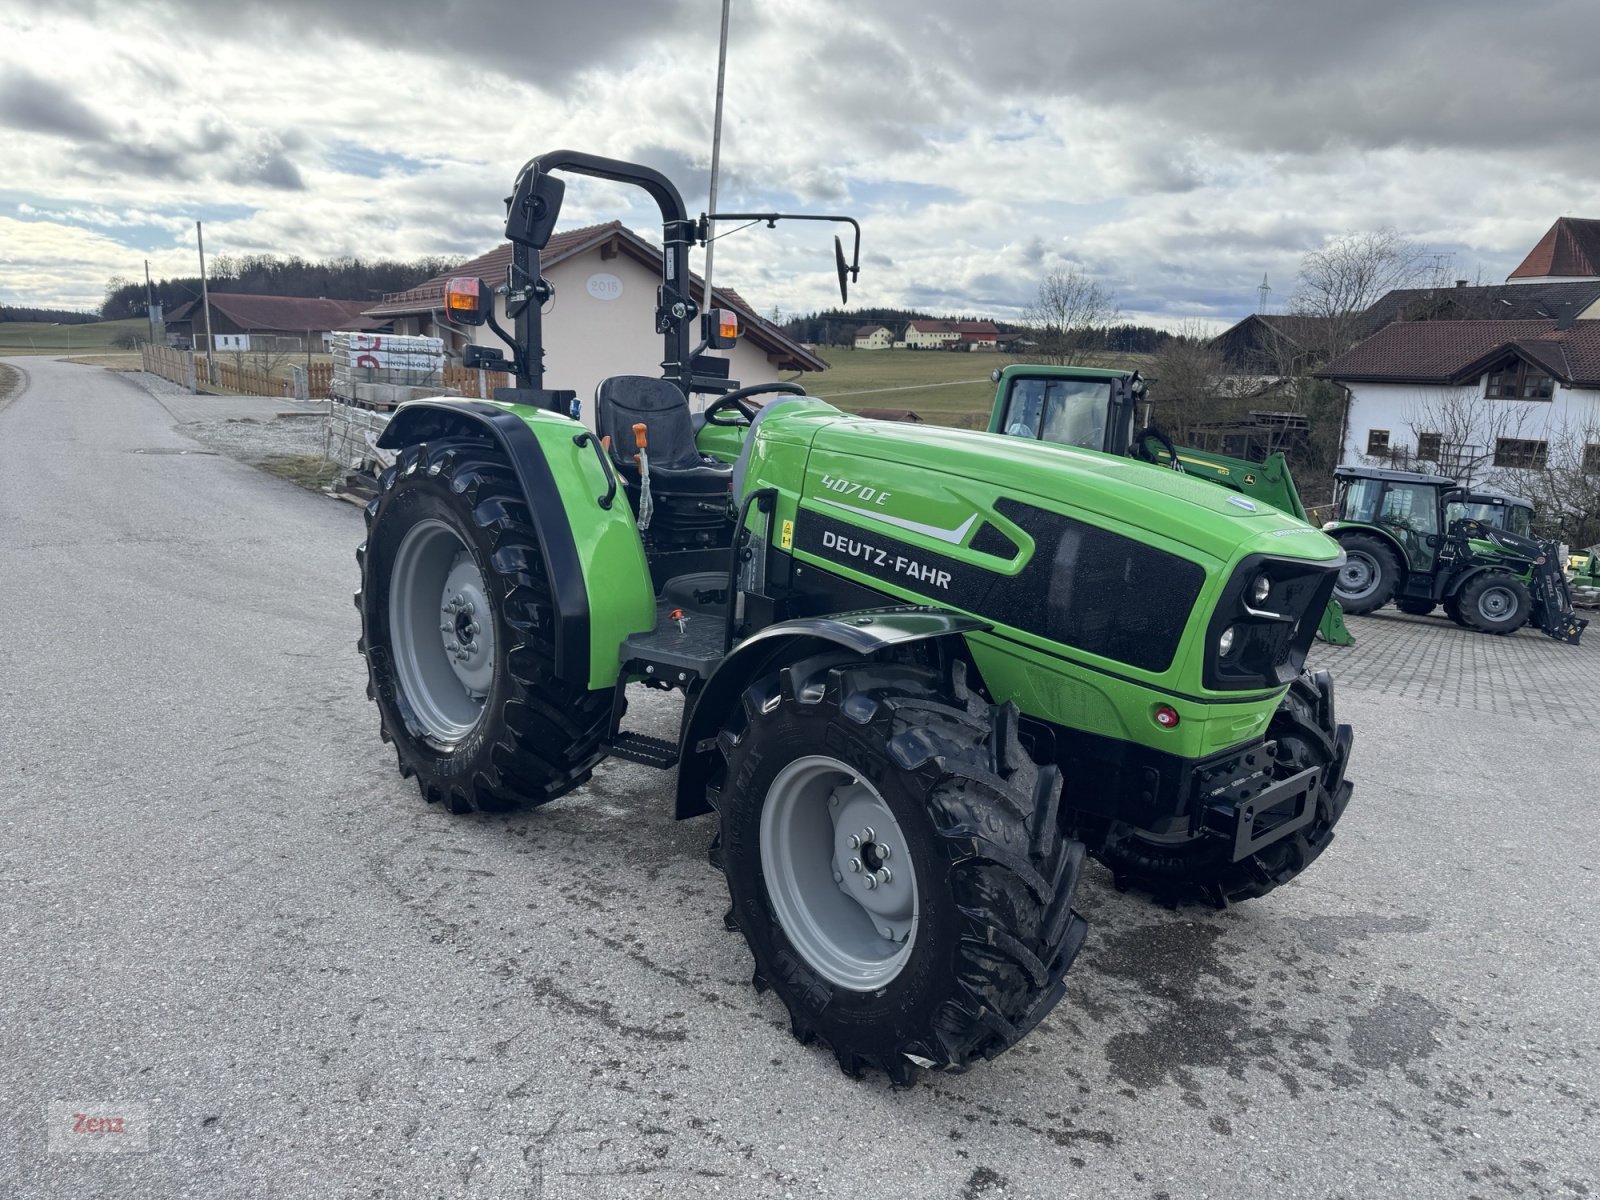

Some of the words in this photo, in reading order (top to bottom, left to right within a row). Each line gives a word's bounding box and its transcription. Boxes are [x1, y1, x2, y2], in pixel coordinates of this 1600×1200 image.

[591, 280, 618, 293] 2015
[821, 474, 877, 500] 4070
[876, 491, 892, 506] E
[822, 531, 952, 590] DEUTZ-FAHR
